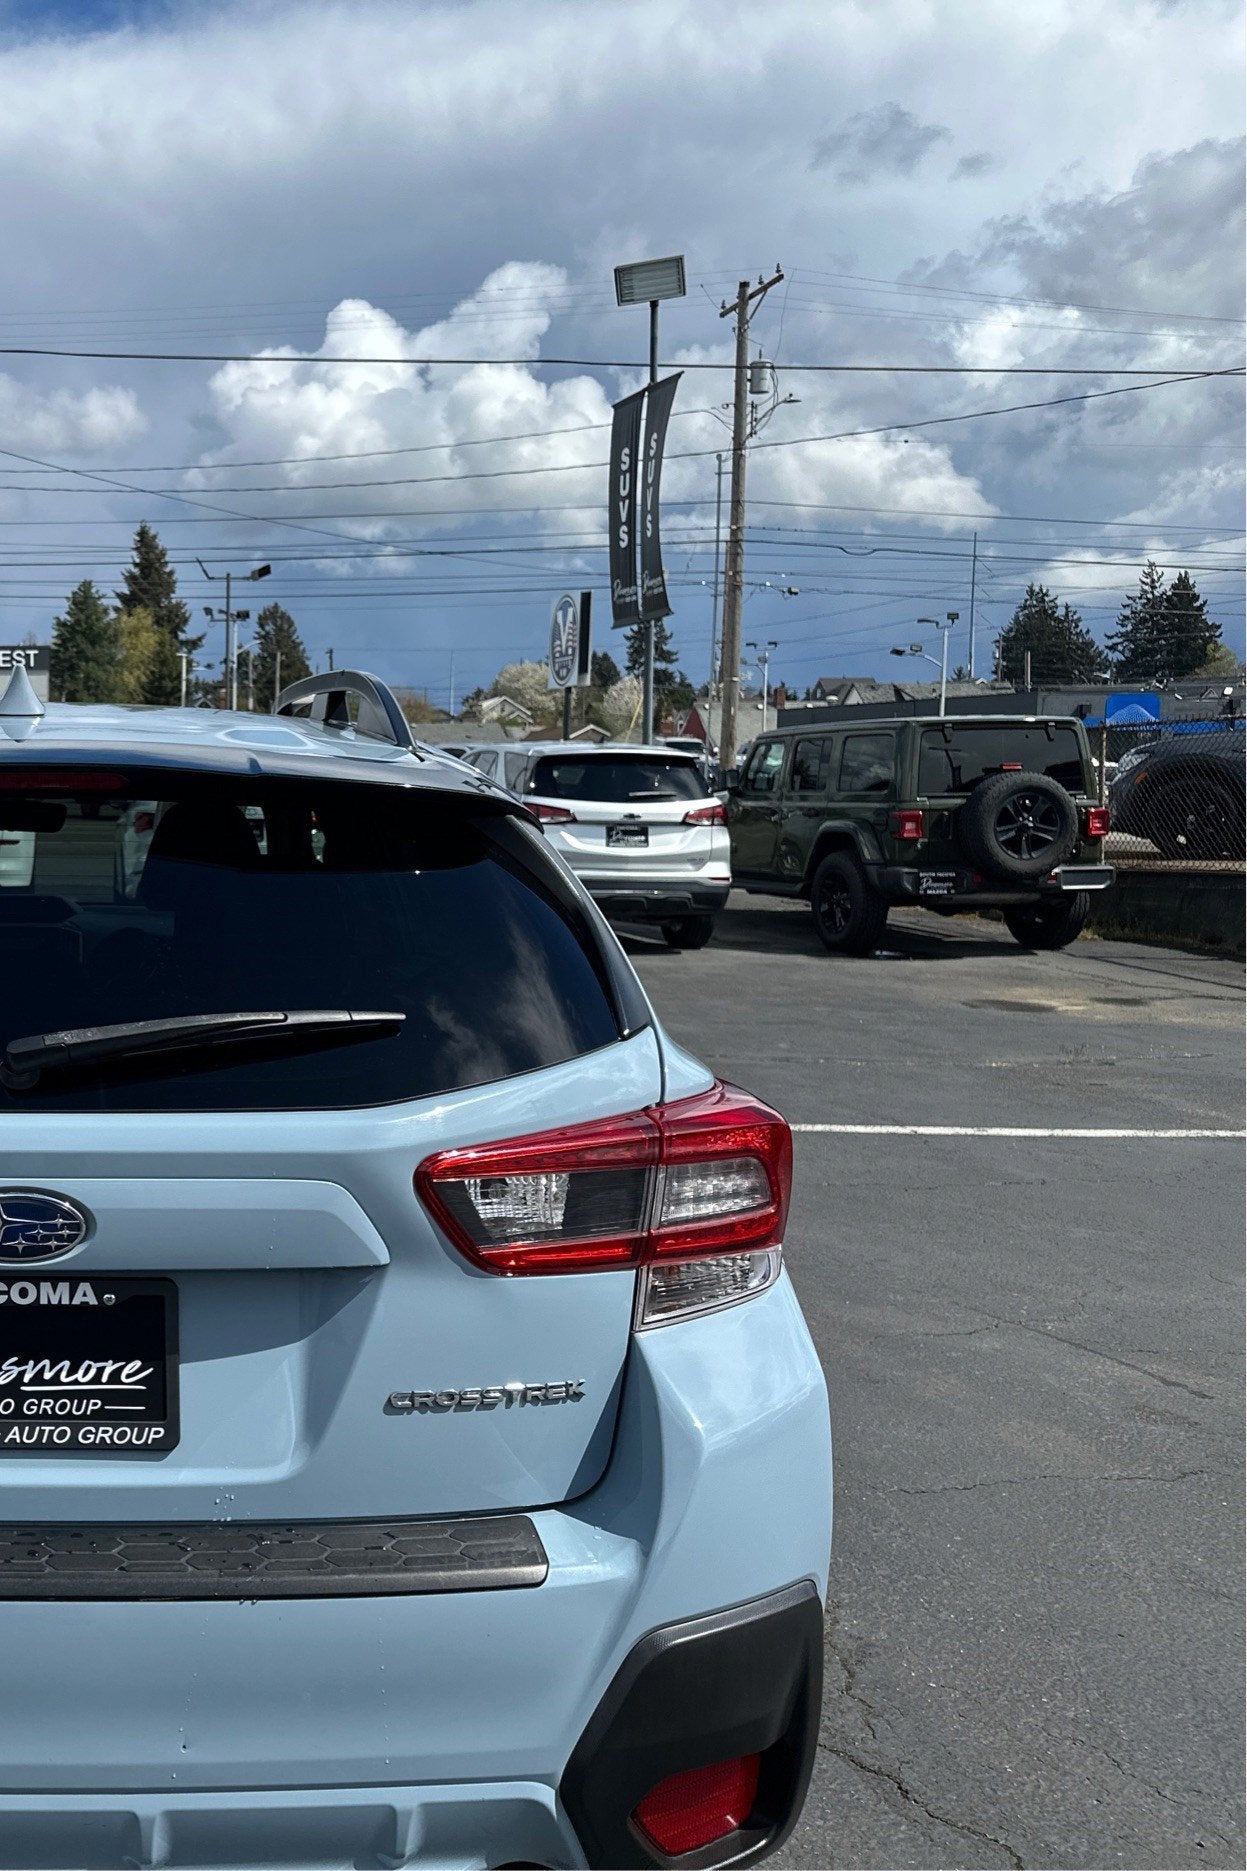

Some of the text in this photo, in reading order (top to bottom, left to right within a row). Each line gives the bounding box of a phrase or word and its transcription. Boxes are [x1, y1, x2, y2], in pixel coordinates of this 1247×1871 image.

[618, 447, 630, 549] SUVS
[646, 432, 658, 538] SUVS
[23, 1399, 102, 1416] GROUP
[390, 1379, 586, 1408] CROSSTREK
[5, 1427, 71, 1444] AUTO
[78, 1427, 164, 1445] GROUP
